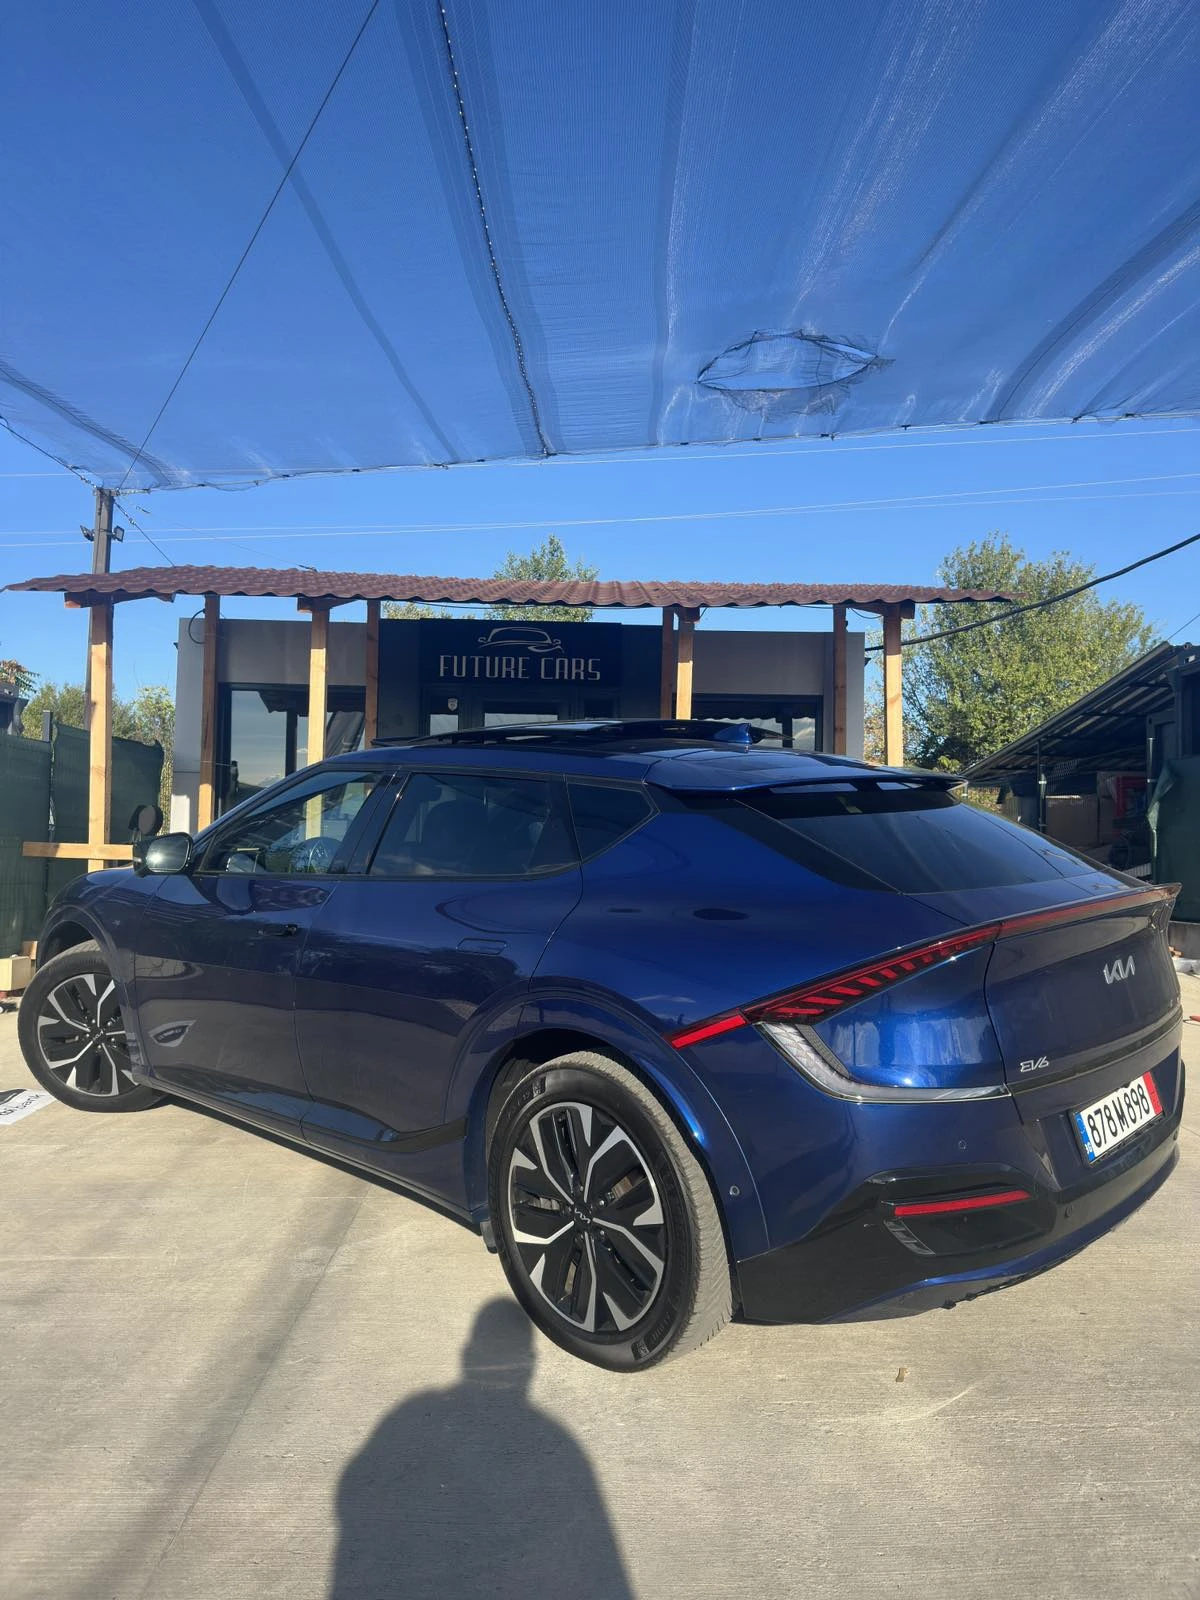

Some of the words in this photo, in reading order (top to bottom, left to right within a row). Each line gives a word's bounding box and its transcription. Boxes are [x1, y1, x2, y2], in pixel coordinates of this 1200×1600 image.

[439, 655, 530, 679] FUTURE
[540, 657, 600, 680] CARS
[1103, 955, 1136, 984] KIA
[1020, 1056, 1050, 1073] EV6
